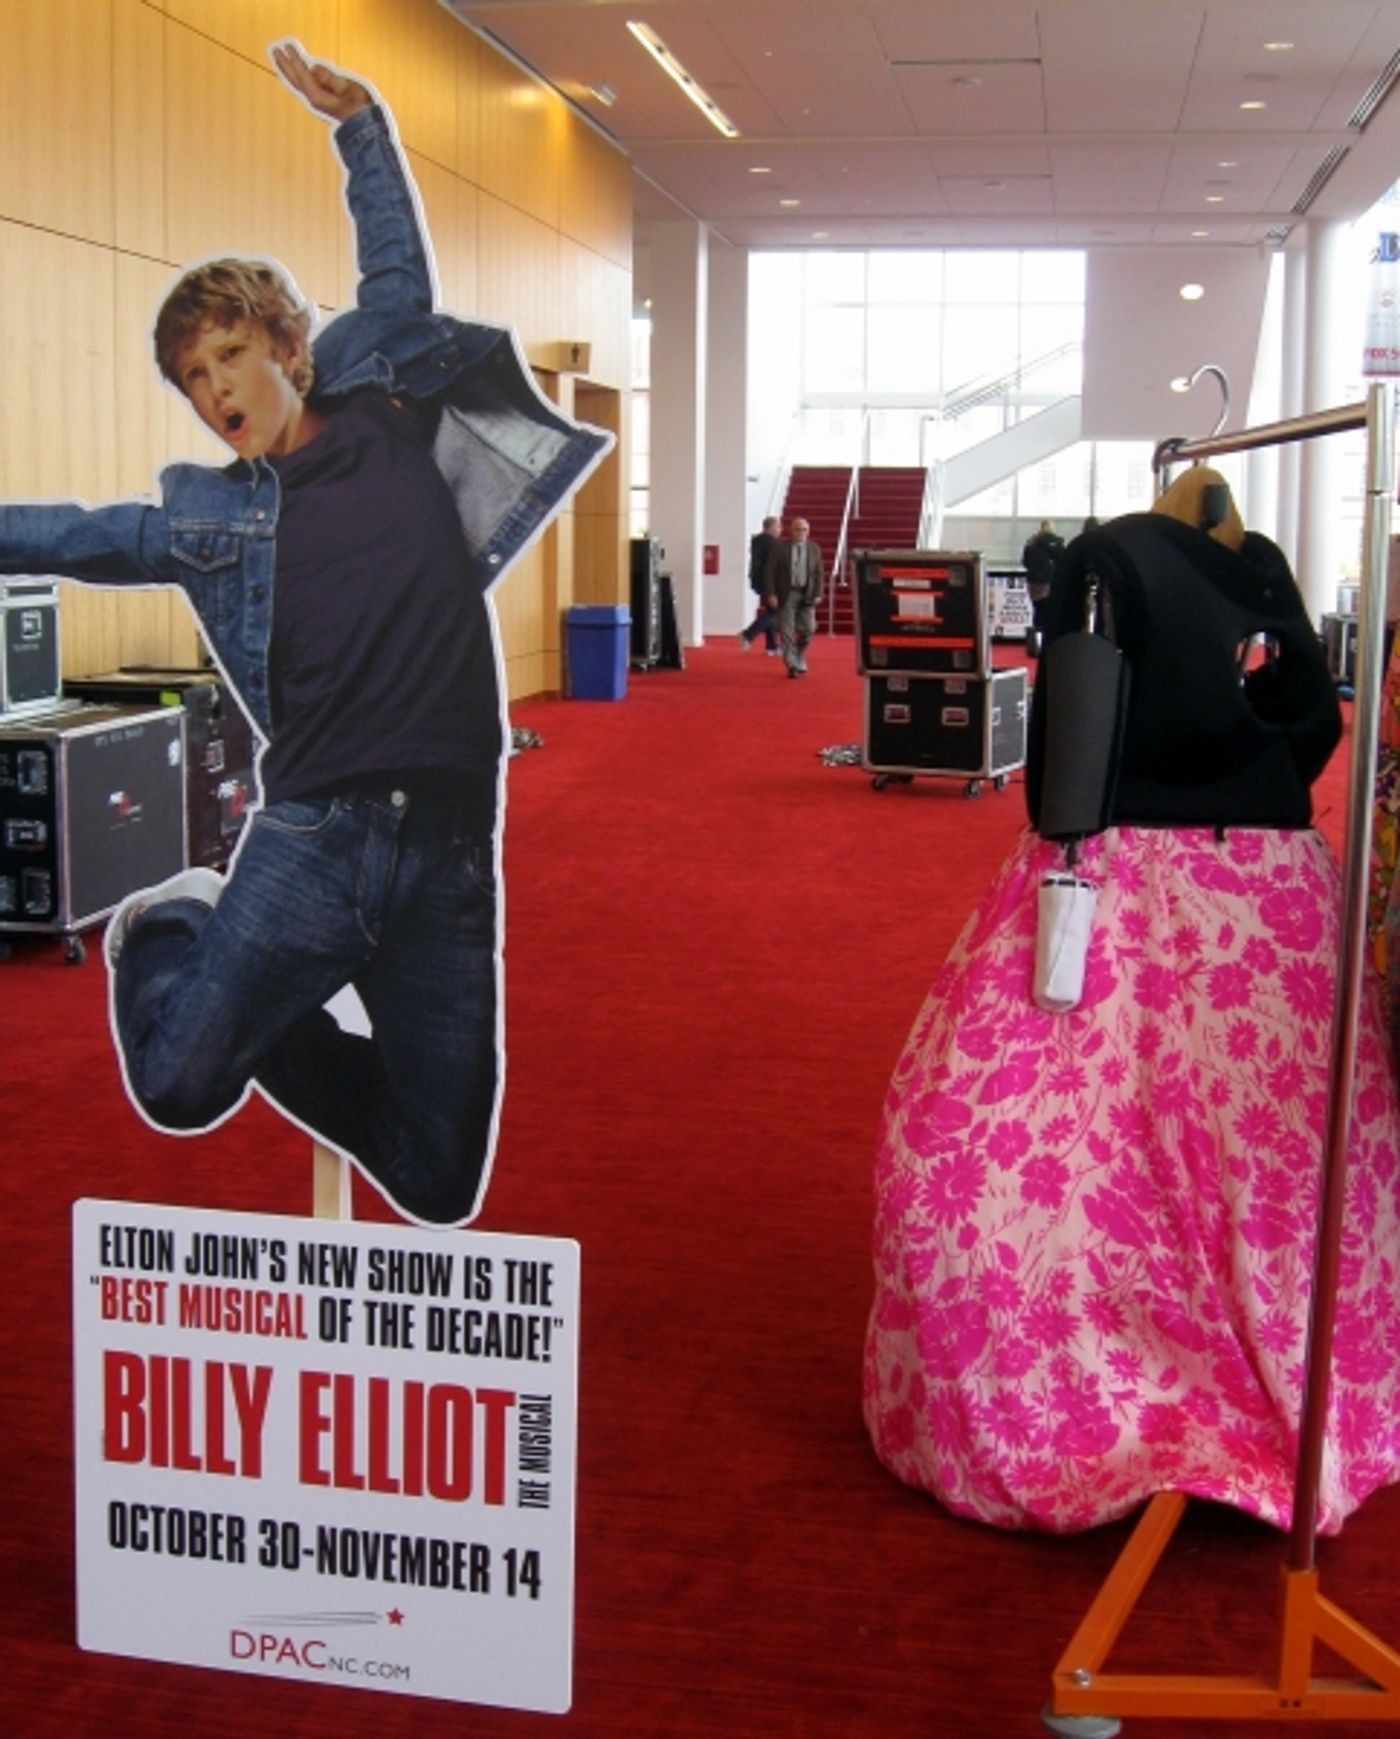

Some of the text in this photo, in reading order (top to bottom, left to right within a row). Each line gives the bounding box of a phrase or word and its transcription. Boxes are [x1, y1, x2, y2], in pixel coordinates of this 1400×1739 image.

[98, 1223, 556, 1308] ELTON JOHN'S NEW SHOW IS THE
[178, 1283, 308, 1339] MUSICAL
[318, 1296, 354, 1343] OF
[361, 1301, 416, 1350] THE
[102, 1350, 517, 1507] BILLY ELLIOT
[518, 1393, 553, 1509] THE MUSICAL
[108, 1501, 247, 1564] OCTOBER
[501, 1550, 542, 1599] 14
